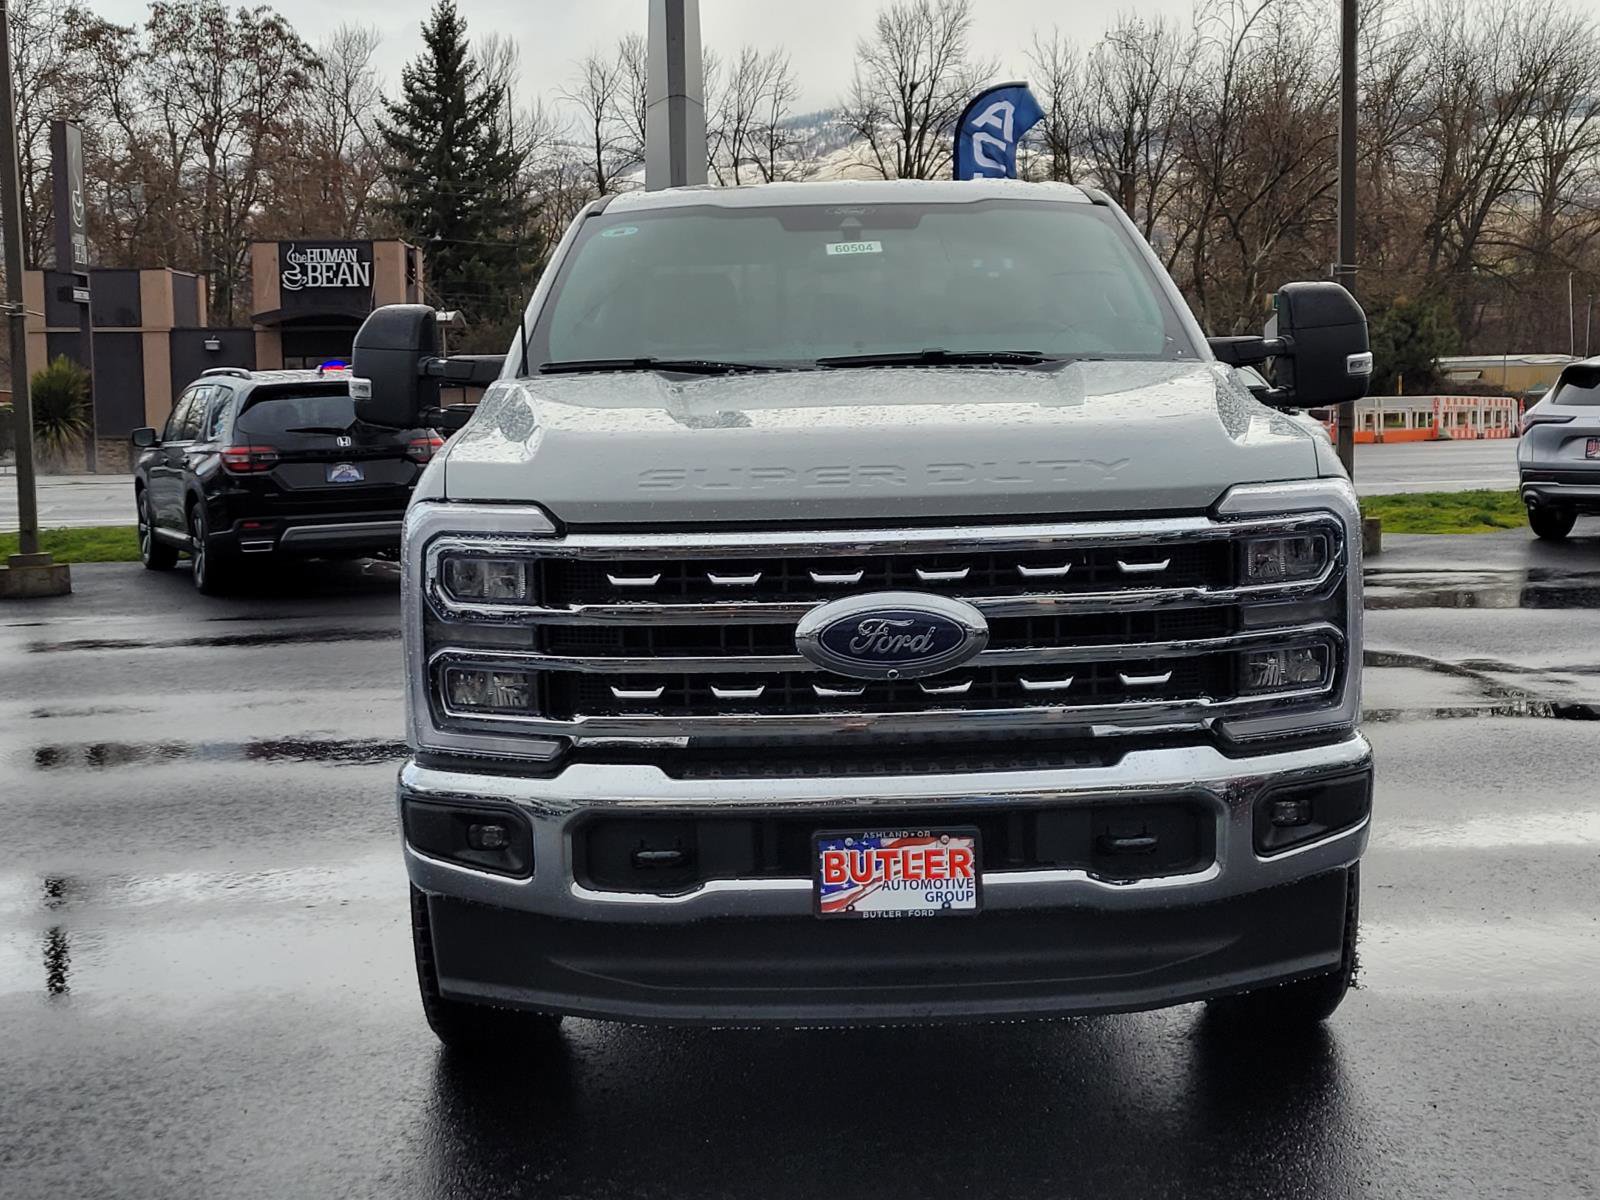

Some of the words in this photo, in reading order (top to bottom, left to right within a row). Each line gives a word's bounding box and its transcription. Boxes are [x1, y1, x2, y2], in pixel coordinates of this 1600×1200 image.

[291, 252, 307, 263] the
[305, 248, 358, 263] HUMAN
[835, 243, 874, 253] 60504
[305, 262, 371, 287] BEAN
[638, 463, 908, 491] SUPER
[927, 457, 1131, 485] DUTY
[849, 618, 937, 654] Ford
[822, 849, 974, 884] BUTLER
[881, 878, 974, 891] AUTOMOTIVE
[925, 891, 974, 902] GROUP
[862, 910, 902, 918] BUTLER
[908, 909, 935, 917] FORD
